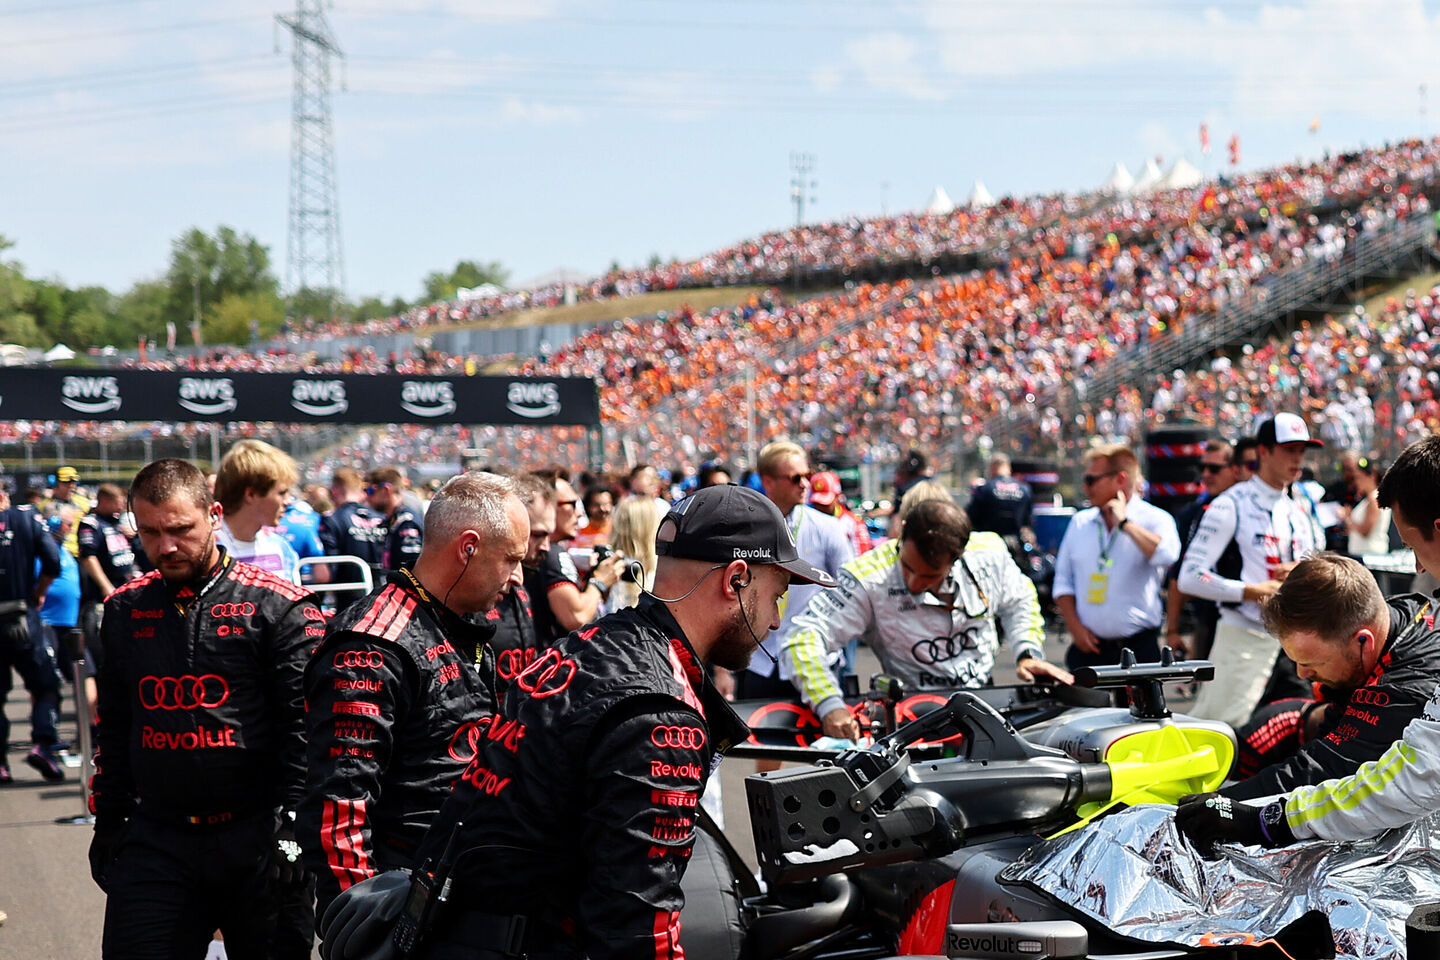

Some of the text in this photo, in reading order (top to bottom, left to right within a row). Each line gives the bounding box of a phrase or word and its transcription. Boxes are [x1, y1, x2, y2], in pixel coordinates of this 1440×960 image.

[61, 376, 120, 398] aws
[178, 377, 235, 400] aws
[291, 379, 346, 401] aws
[401, 380, 454, 402] aws
[507, 382, 559, 403] aws
[733, 546, 771, 560] Revolut
[333, 678, 384, 693] Revolut
[332, 701, 381, 717] PIRELLI
[142, 725, 237, 749] Revolut
[650, 760, 701, 780] Revolut
[949, 931, 1016, 953] Revolut
